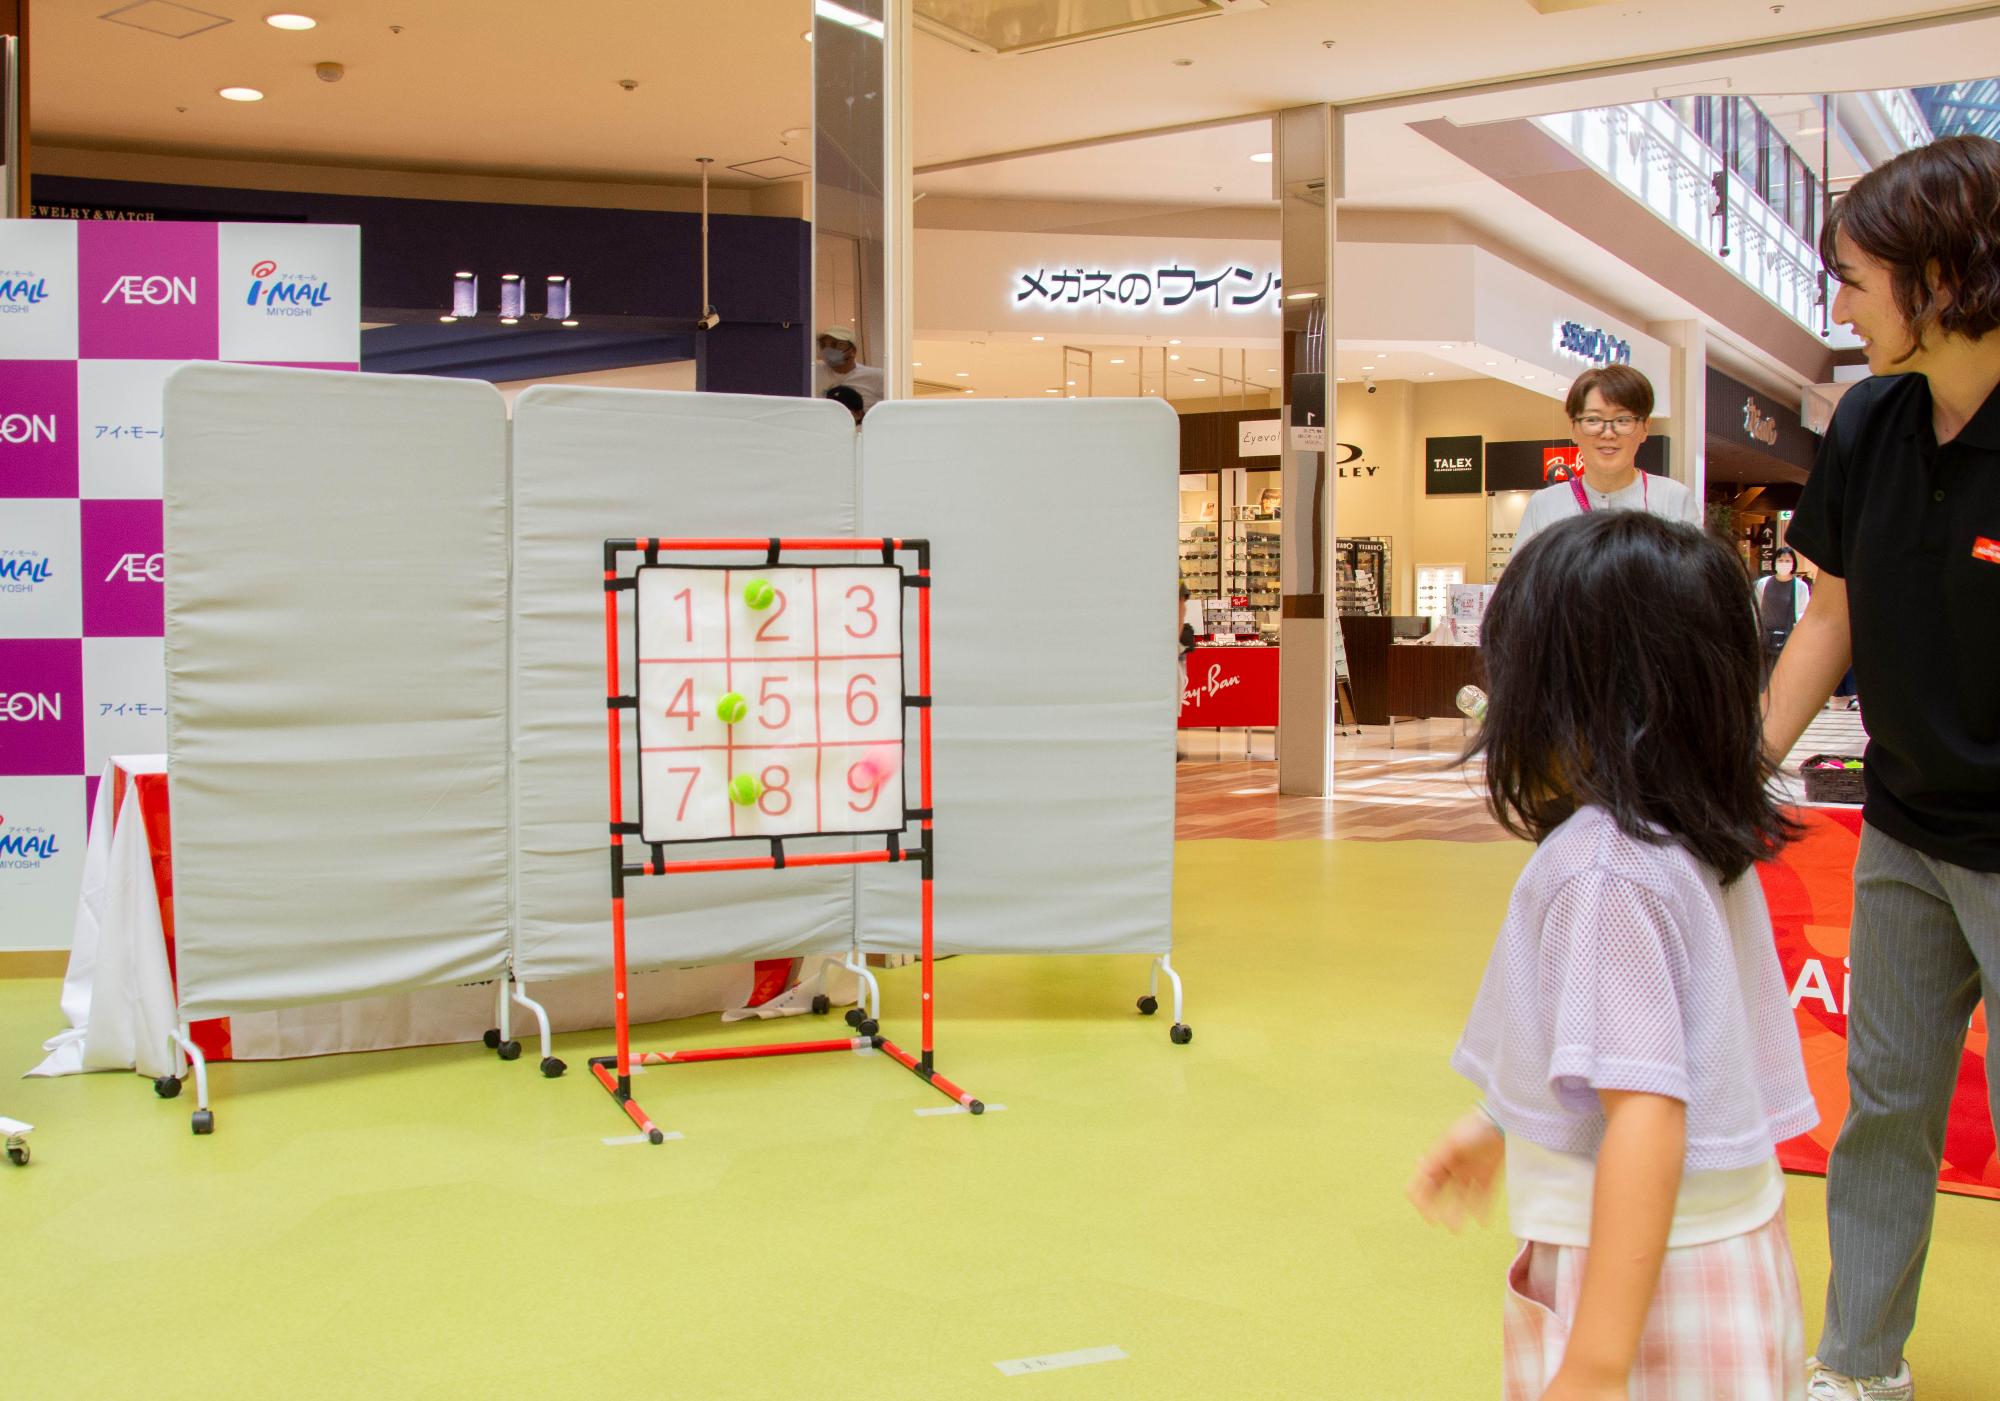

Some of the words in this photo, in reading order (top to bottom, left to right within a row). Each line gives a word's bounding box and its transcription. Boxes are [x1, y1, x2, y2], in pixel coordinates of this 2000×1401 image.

[1016, 264, 1282, 309] メガネのウイン
[266, 307, 312, 316] MIYOSHI
[95, 425, 165, 439] アイ・モー
[1434, 458, 1472, 469] TALEX
[673, 588, 693, 642] 1
[755, 588, 790, 642] 2
[844, 584, 878, 639] 3
[100, 703, 168, 716] アイ・モー
[664, 677, 701, 732] 4
[758, 676, 791, 730] 5
[846, 673, 879, 726] 6
[667, 766, 701, 822] 7
[758, 765, 792, 816] 8
[847, 760, 880, 813] 9
